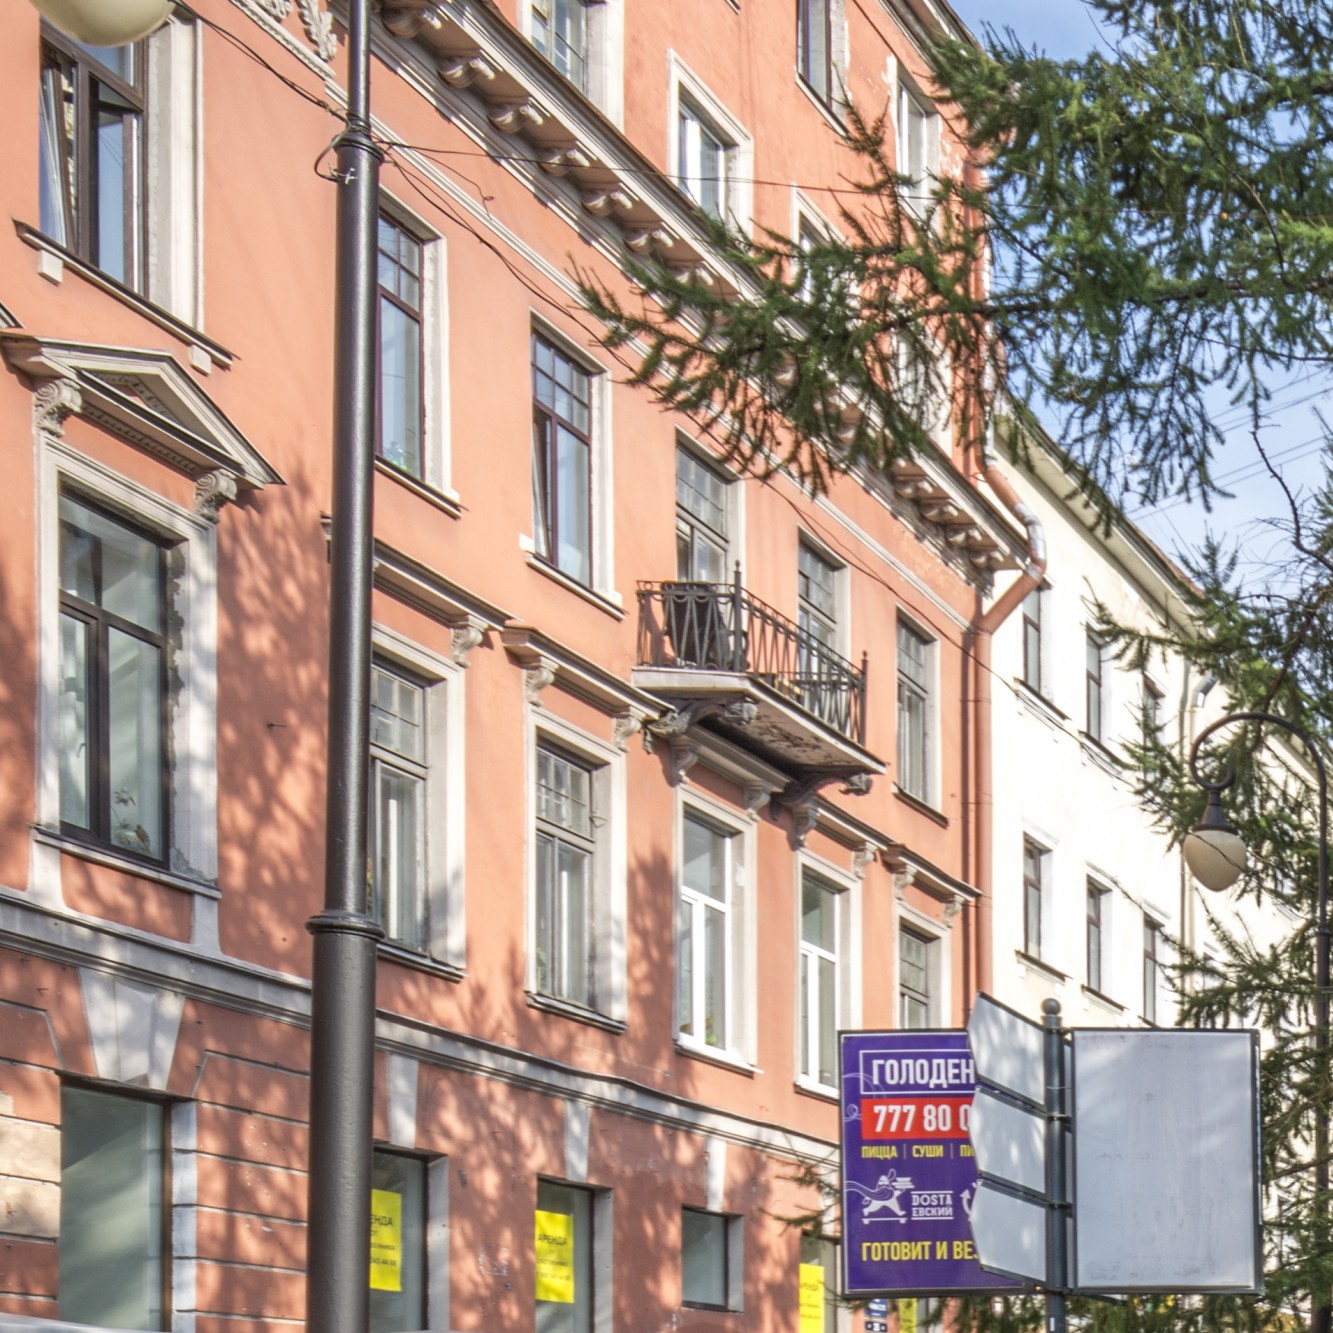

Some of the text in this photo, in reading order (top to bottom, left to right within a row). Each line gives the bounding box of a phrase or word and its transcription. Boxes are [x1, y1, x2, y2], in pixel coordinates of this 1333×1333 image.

[872, 1059, 976, 1088] ГОЛОДЕН
[873, 1104, 971, 1132] 777 80 0
[861, 1144, 975, 1159] ПИЦЦА СУШИ ПИ
[912, 1194, 952, 1205] DOSTA
[912, 1205, 953, 1217] ЕВСКИЙ
[371, 1215, 393, 1227] ЕНДА
[538, 1233, 567, 1246] АРЕНДА
[862, 1241, 932, 1261] ГОТОВИТ
[936, 1241, 947, 1260] И
